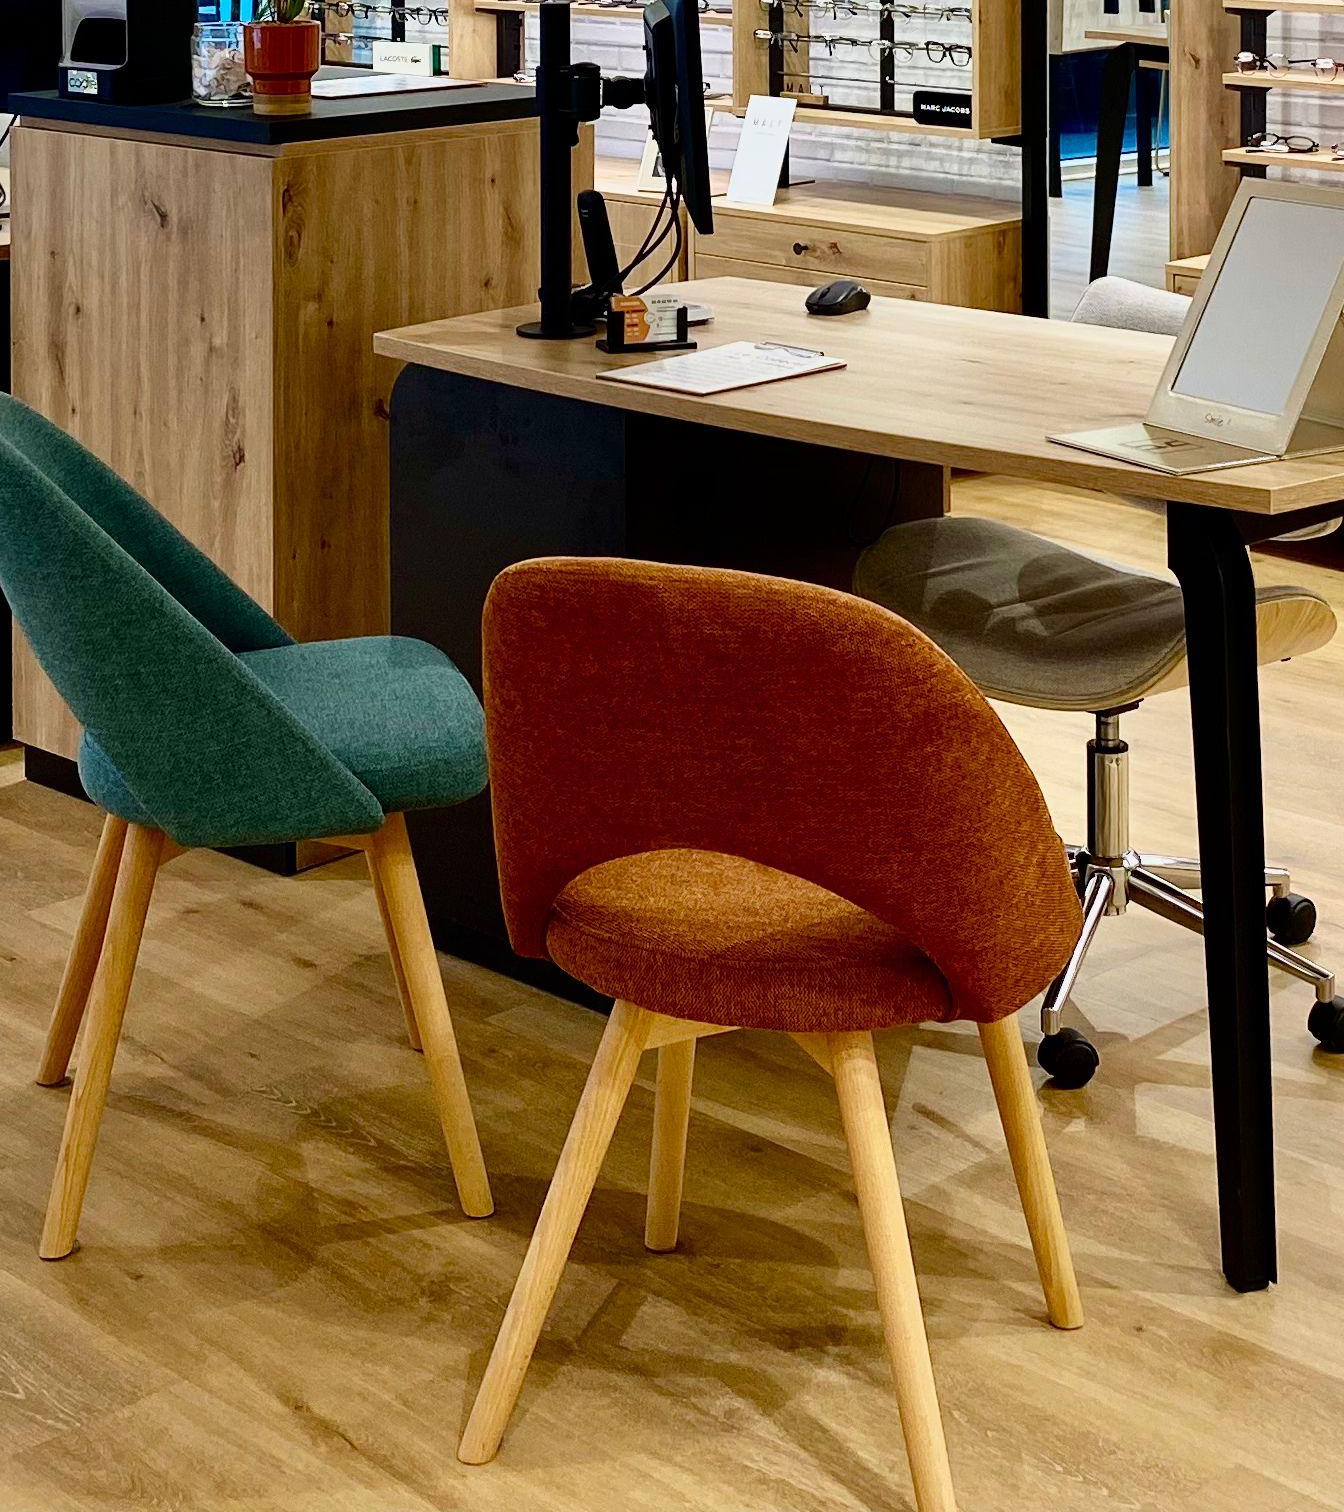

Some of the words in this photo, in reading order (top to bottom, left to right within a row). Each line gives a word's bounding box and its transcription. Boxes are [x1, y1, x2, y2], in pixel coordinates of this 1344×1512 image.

[379, 55, 409, 63] LACOSTE
[920, 103, 941, 113] MARC
[941, 105, 971, 116] JACOBS
